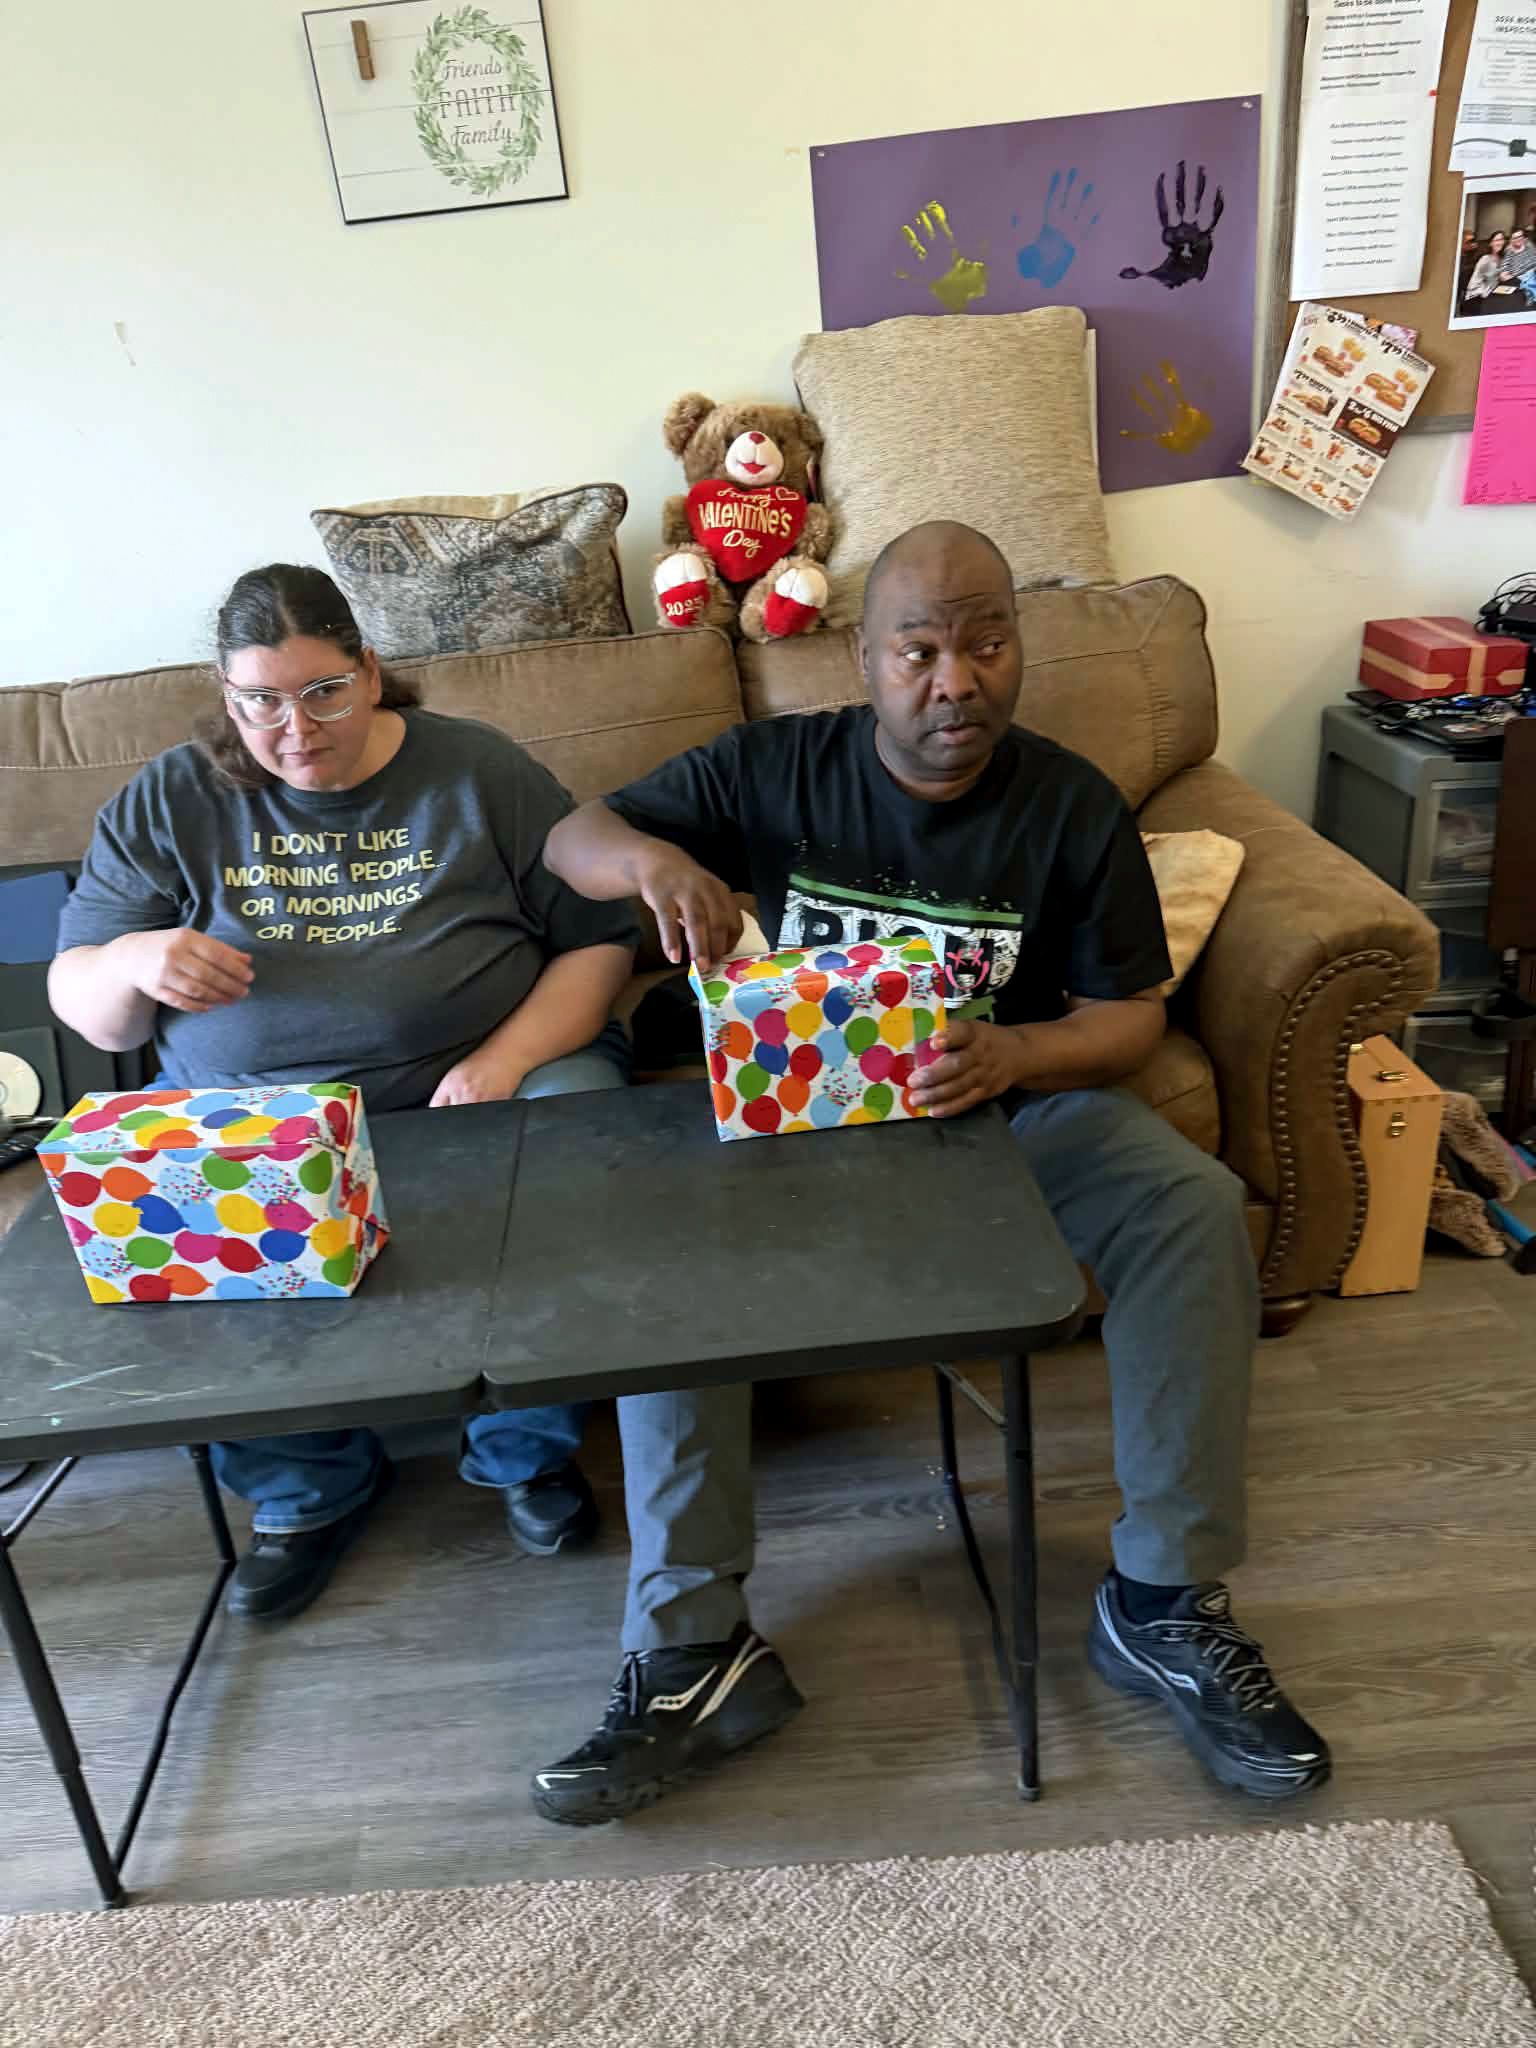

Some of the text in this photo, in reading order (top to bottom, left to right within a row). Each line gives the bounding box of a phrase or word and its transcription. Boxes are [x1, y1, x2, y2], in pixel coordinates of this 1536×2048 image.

[441, 55, 504, 81] Friends
[438, 84, 517, 119] FAITH
[451, 120, 515, 146] Family
[722, 529, 763, 558] Day
[252, 827, 411, 856] I DON'T LIKE
[224, 863, 339, 888] MORNING
[240, 882, 424, 917] OR MORNINGS.
[255, 915, 403, 945] OR PEOPLE.
